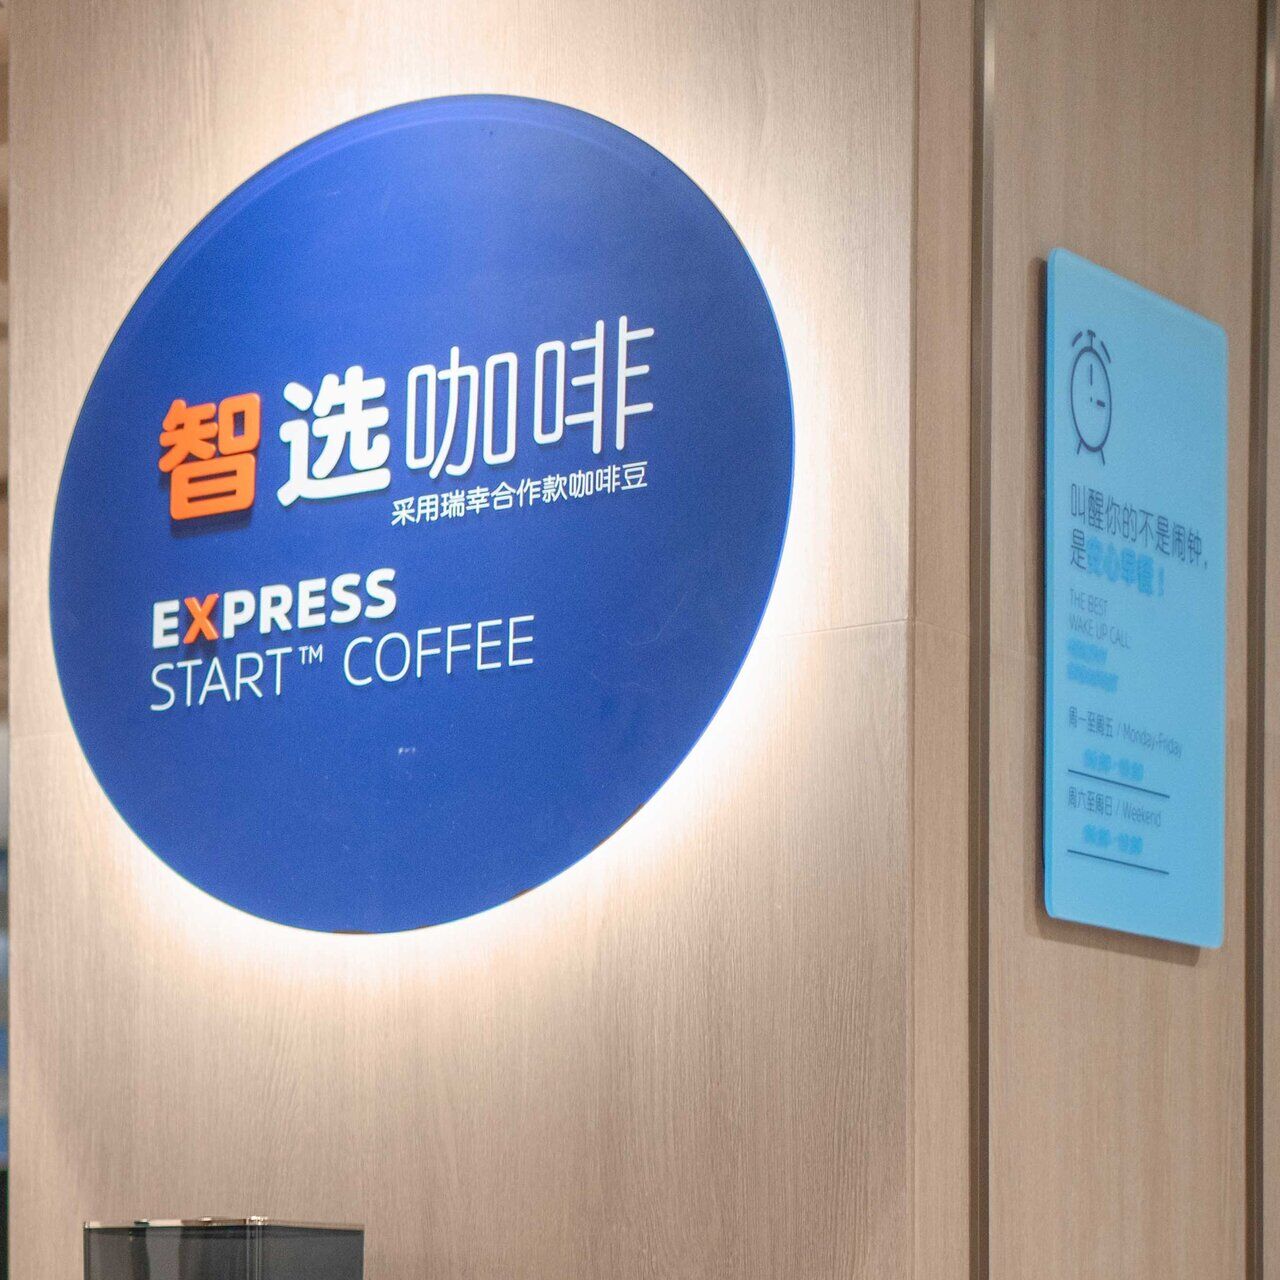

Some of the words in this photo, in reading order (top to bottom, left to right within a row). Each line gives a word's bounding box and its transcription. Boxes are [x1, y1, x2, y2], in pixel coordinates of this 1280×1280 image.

[158, 315, 654, 520] 智选咖啡
[391, 461, 648, 526] 采用瑞幸合作款咖啡豆
[153, 567, 397, 650] EXPRESS
[1069, 588, 1086, 611] THE
[1087, 594, 1108, 616] BEST
[1069, 612, 1093, 637] WAKE
[1095, 622, 1108, 640] UP
[343, 615, 535, 687] COFFEE
[1068, 706, 1113, 738] 周一至周五
[1068, 786, 1113, 817] 周六至周日
[1122, 801, 1162, 828] Weekend
